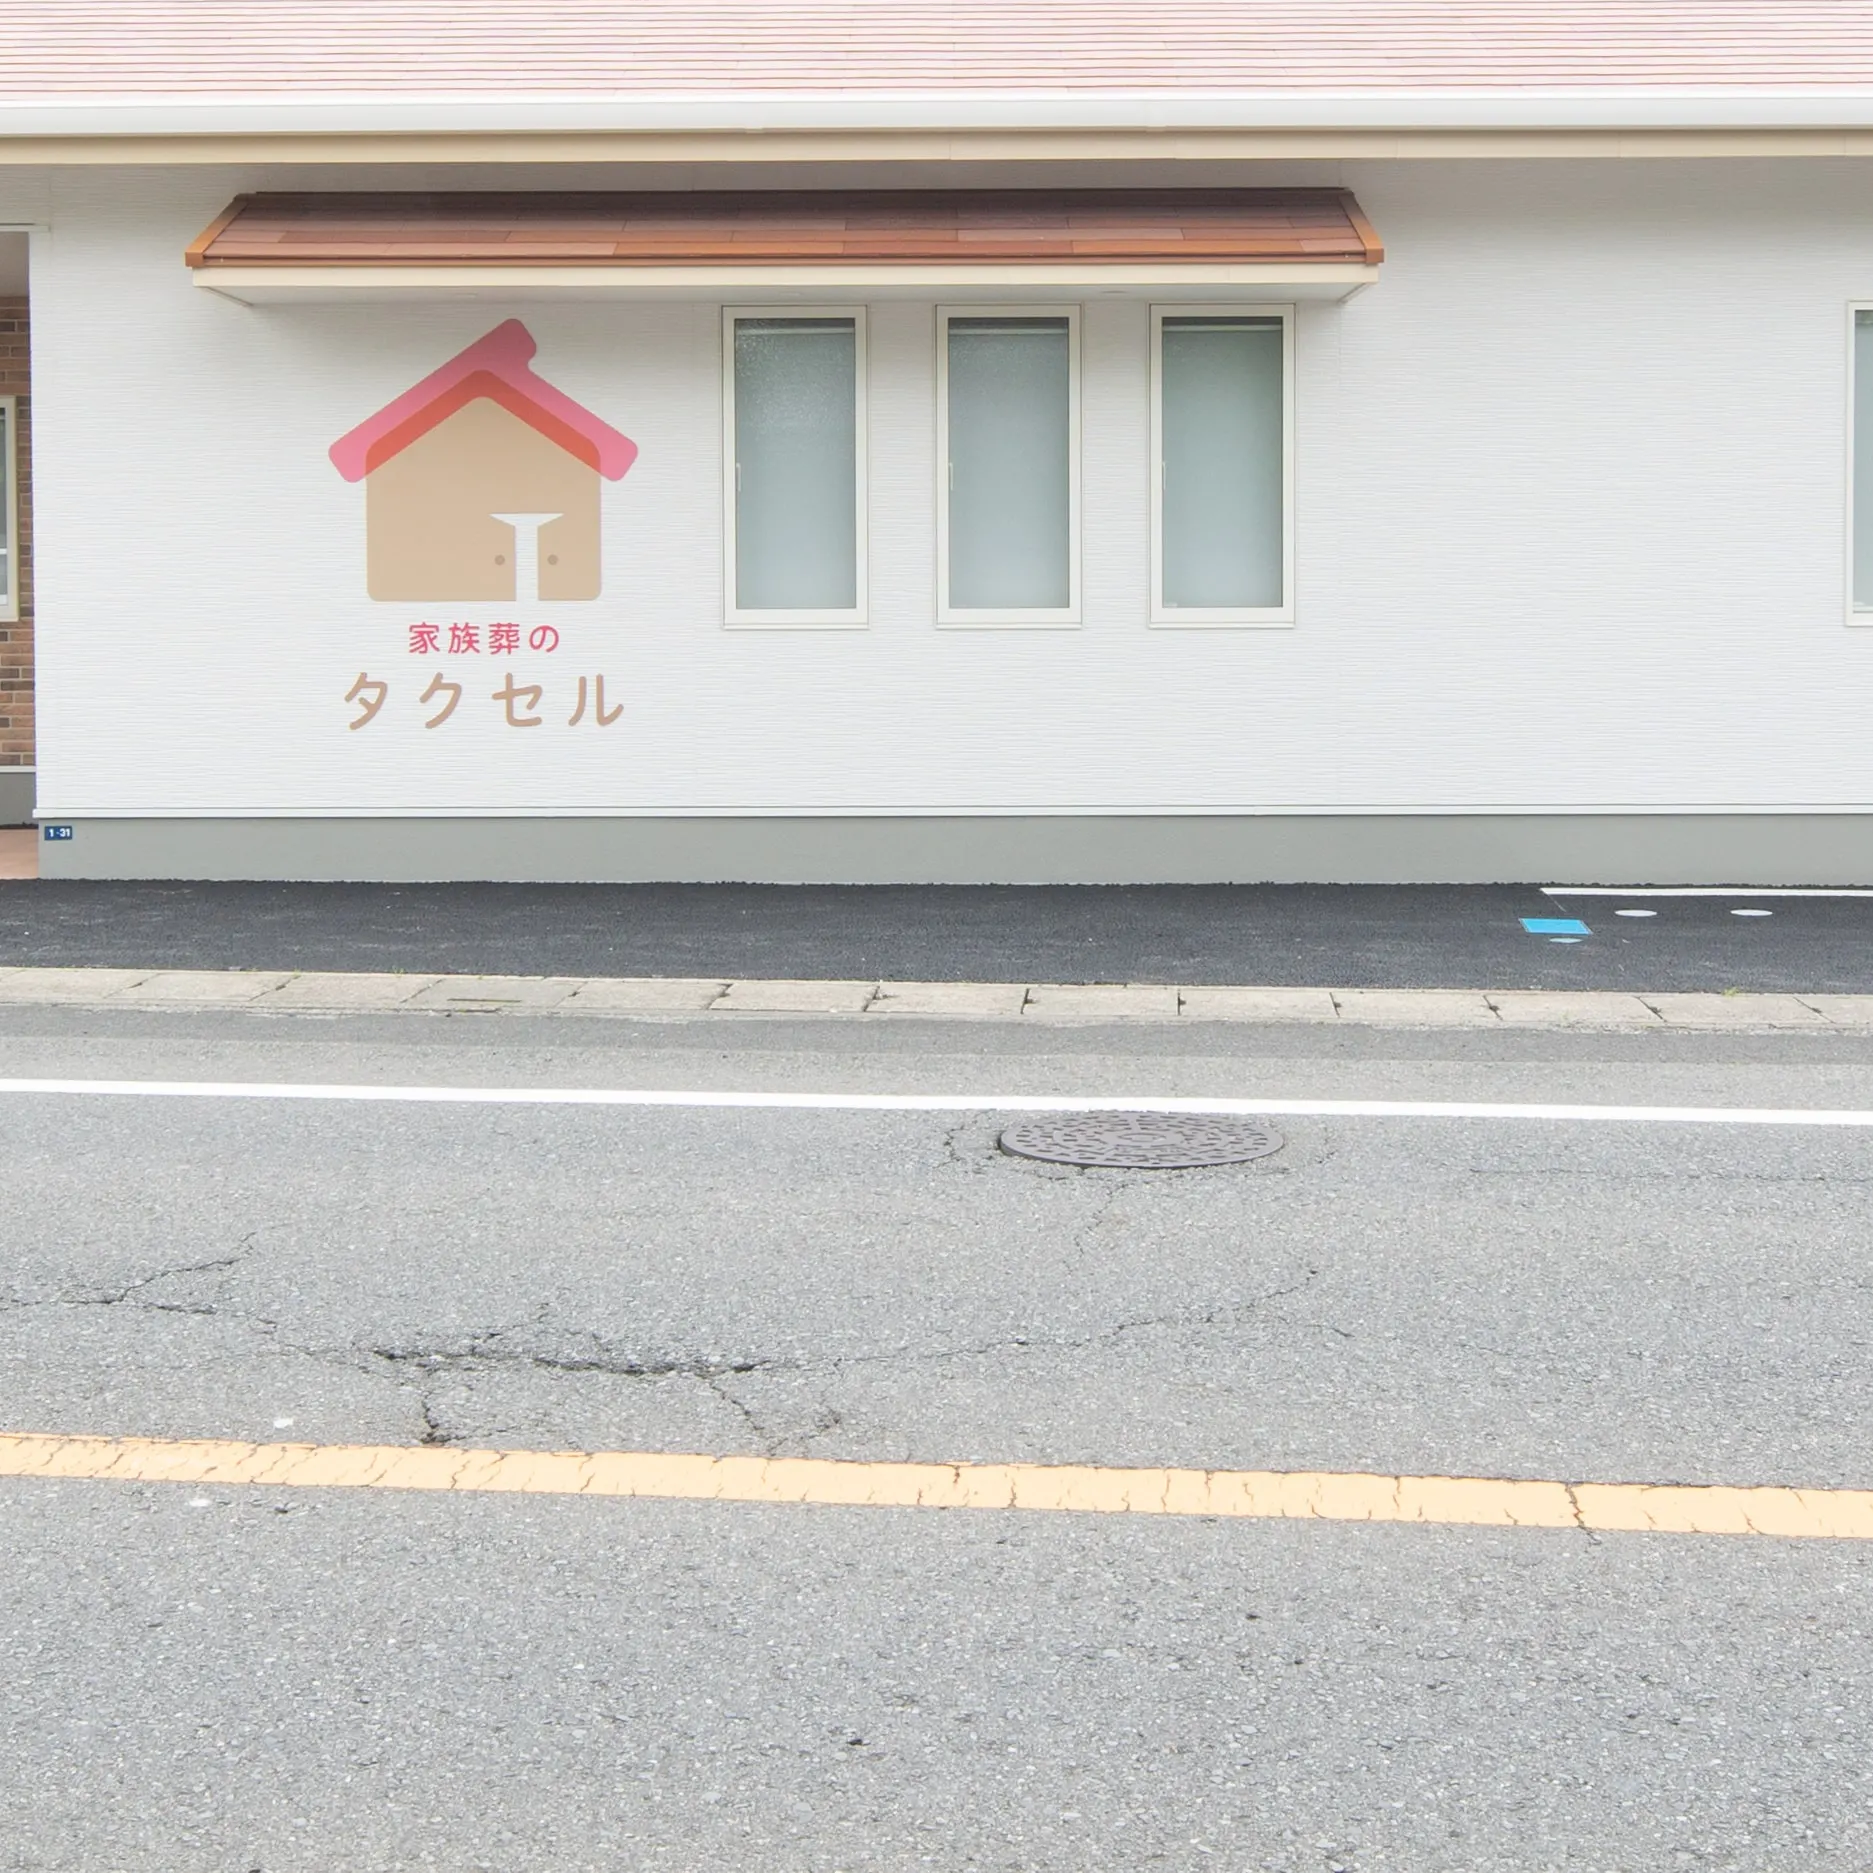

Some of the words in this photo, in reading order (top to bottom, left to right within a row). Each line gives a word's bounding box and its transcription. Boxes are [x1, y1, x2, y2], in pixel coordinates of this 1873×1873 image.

[408, 621, 560, 656] 家族葬の
[344, 671, 625, 731] タクセル
